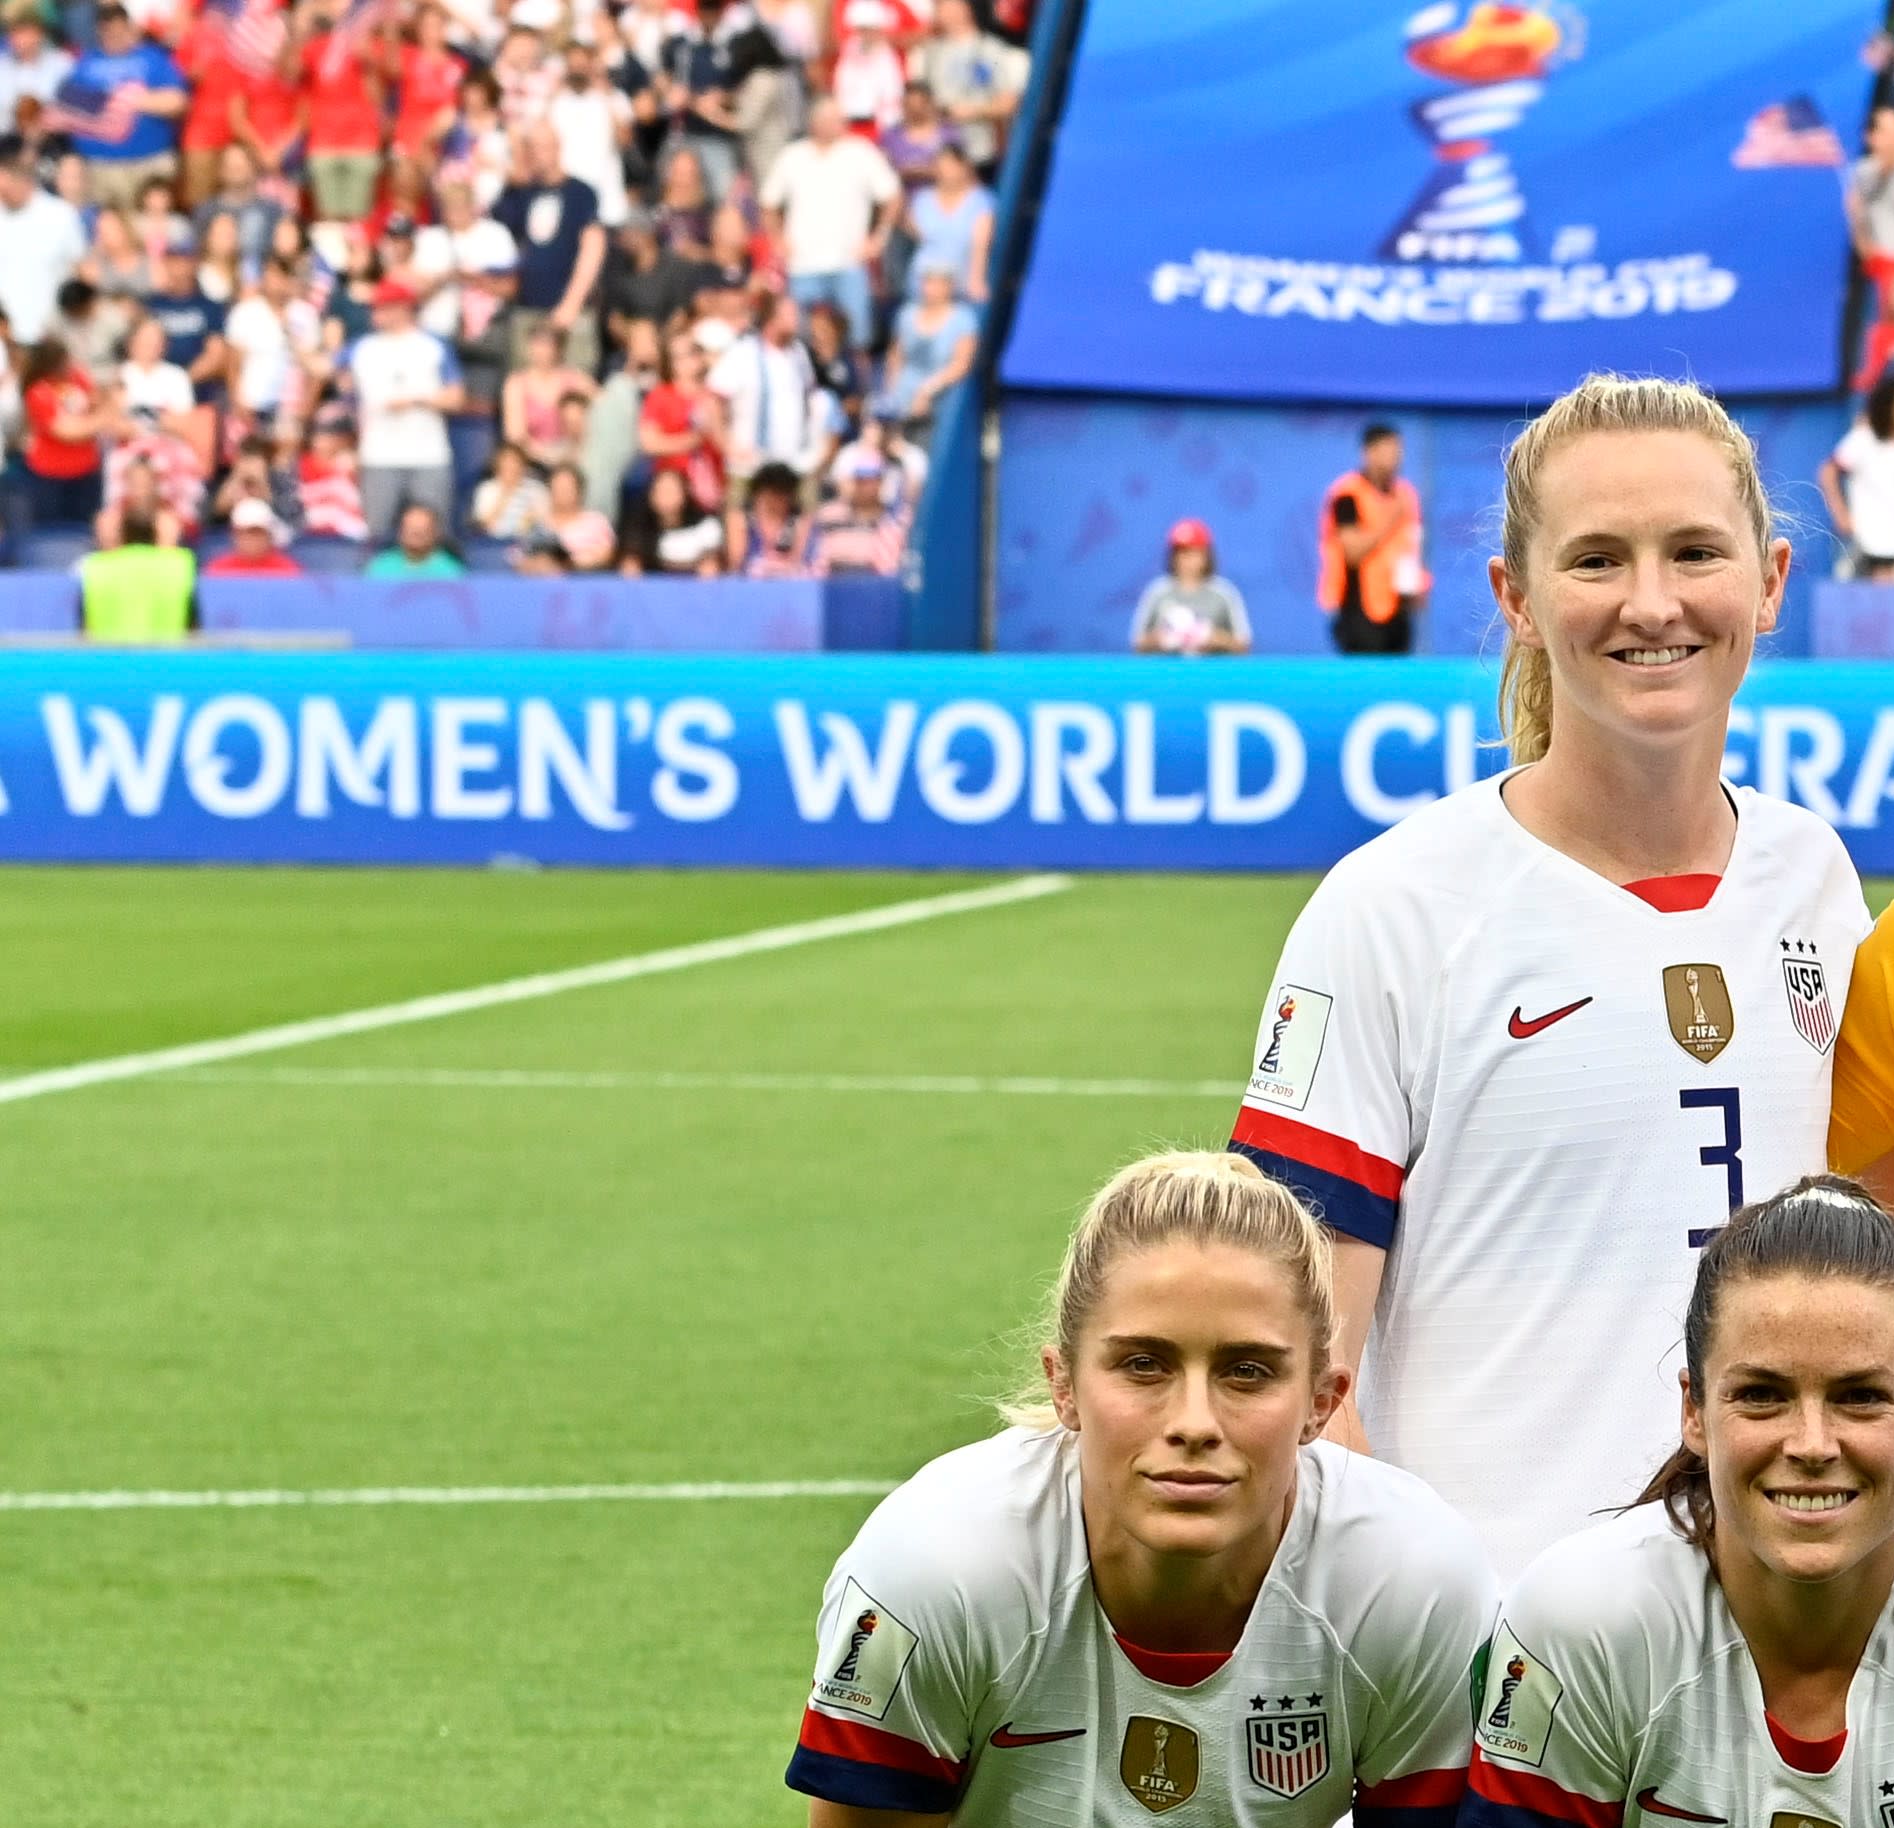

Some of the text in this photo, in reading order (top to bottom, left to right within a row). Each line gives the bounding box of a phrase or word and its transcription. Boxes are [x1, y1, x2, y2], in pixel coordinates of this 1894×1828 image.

[1151, 263, 1736, 324] FRANCE 2019
[40, 692, 741, 832] WOMEN'S
[773, 699, 1308, 826] WORLD
[1788, 966, 1821, 1001] USA
[1687, 1025, 1718, 1038] FIFA
[1273, 1083, 1294, 1098] 2019
[1679, 1087, 1744, 1249] 3
[819, 1683, 846, 1700] ANCE
[847, 1692, 873, 1706] 2019
[1254, 1720, 1322, 1752] USA
[1502, 1737, 1529, 1753] 2019
[1140, 1775, 1175, 1792] FIFA
